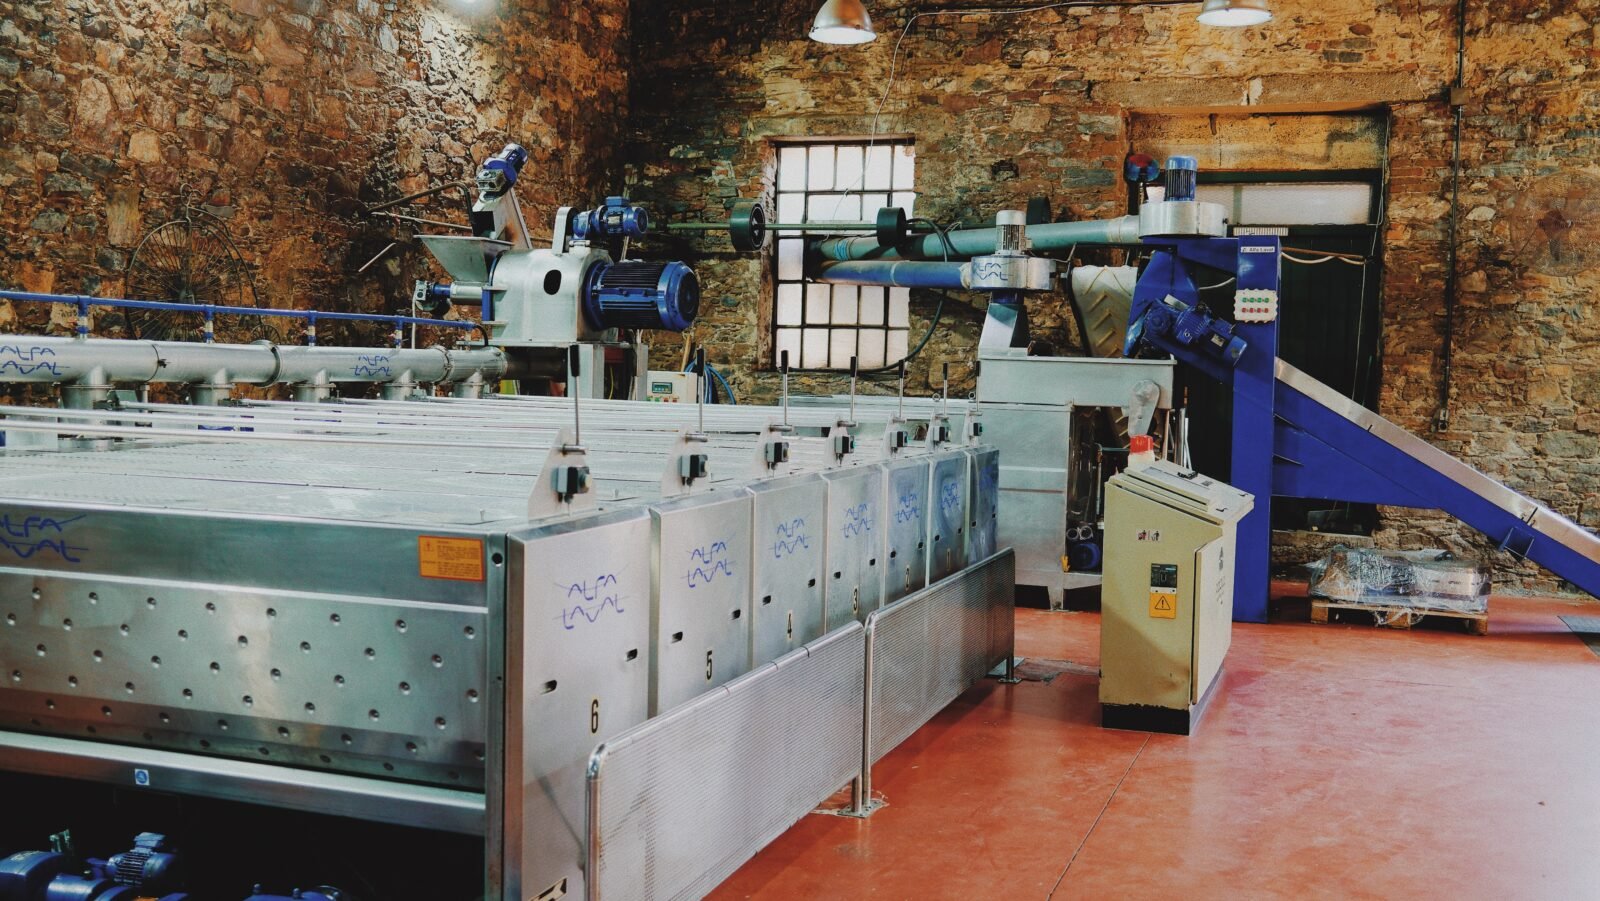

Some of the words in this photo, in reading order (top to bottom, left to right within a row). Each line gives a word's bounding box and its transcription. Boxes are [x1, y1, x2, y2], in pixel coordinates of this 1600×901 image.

[0, 360, 62, 376] AVAL
[0, 514, 63, 538] LFA
[690, 541, 727, 564] ALFA
[686, 558, 733, 588] LAVAL
[567, 574, 617, 601] ALFA
[853, 588, 858, 612] 3
[562, 594, 626, 630] LAVAL
[787, 613, 793, 639] 4
[706, 650, 713, 681] 5
[591, 699, 599, 734] 6
